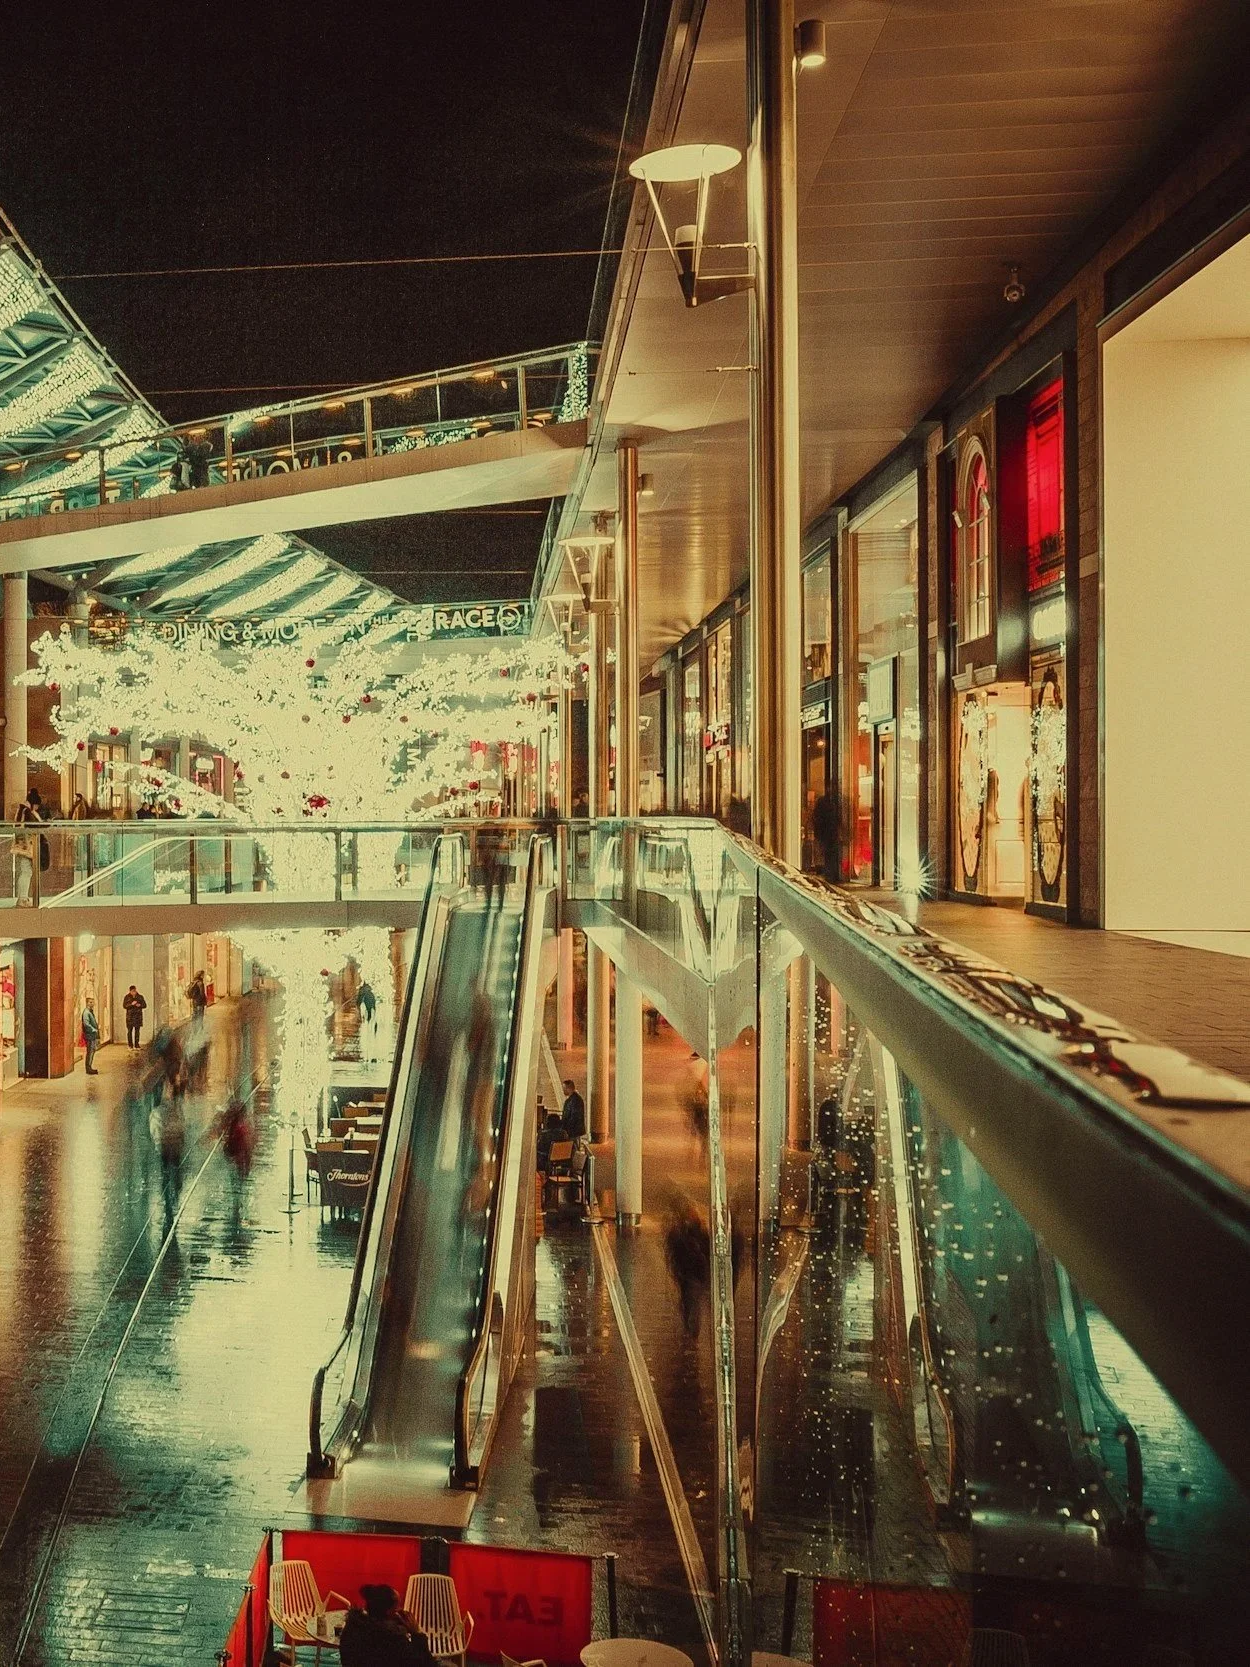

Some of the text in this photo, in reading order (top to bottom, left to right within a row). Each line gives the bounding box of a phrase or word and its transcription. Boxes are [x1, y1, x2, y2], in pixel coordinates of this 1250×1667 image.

[163, 619, 239, 643] DINING
[242, 620, 257, 640] &
[327, 1168, 369, 1182] Thorntons
